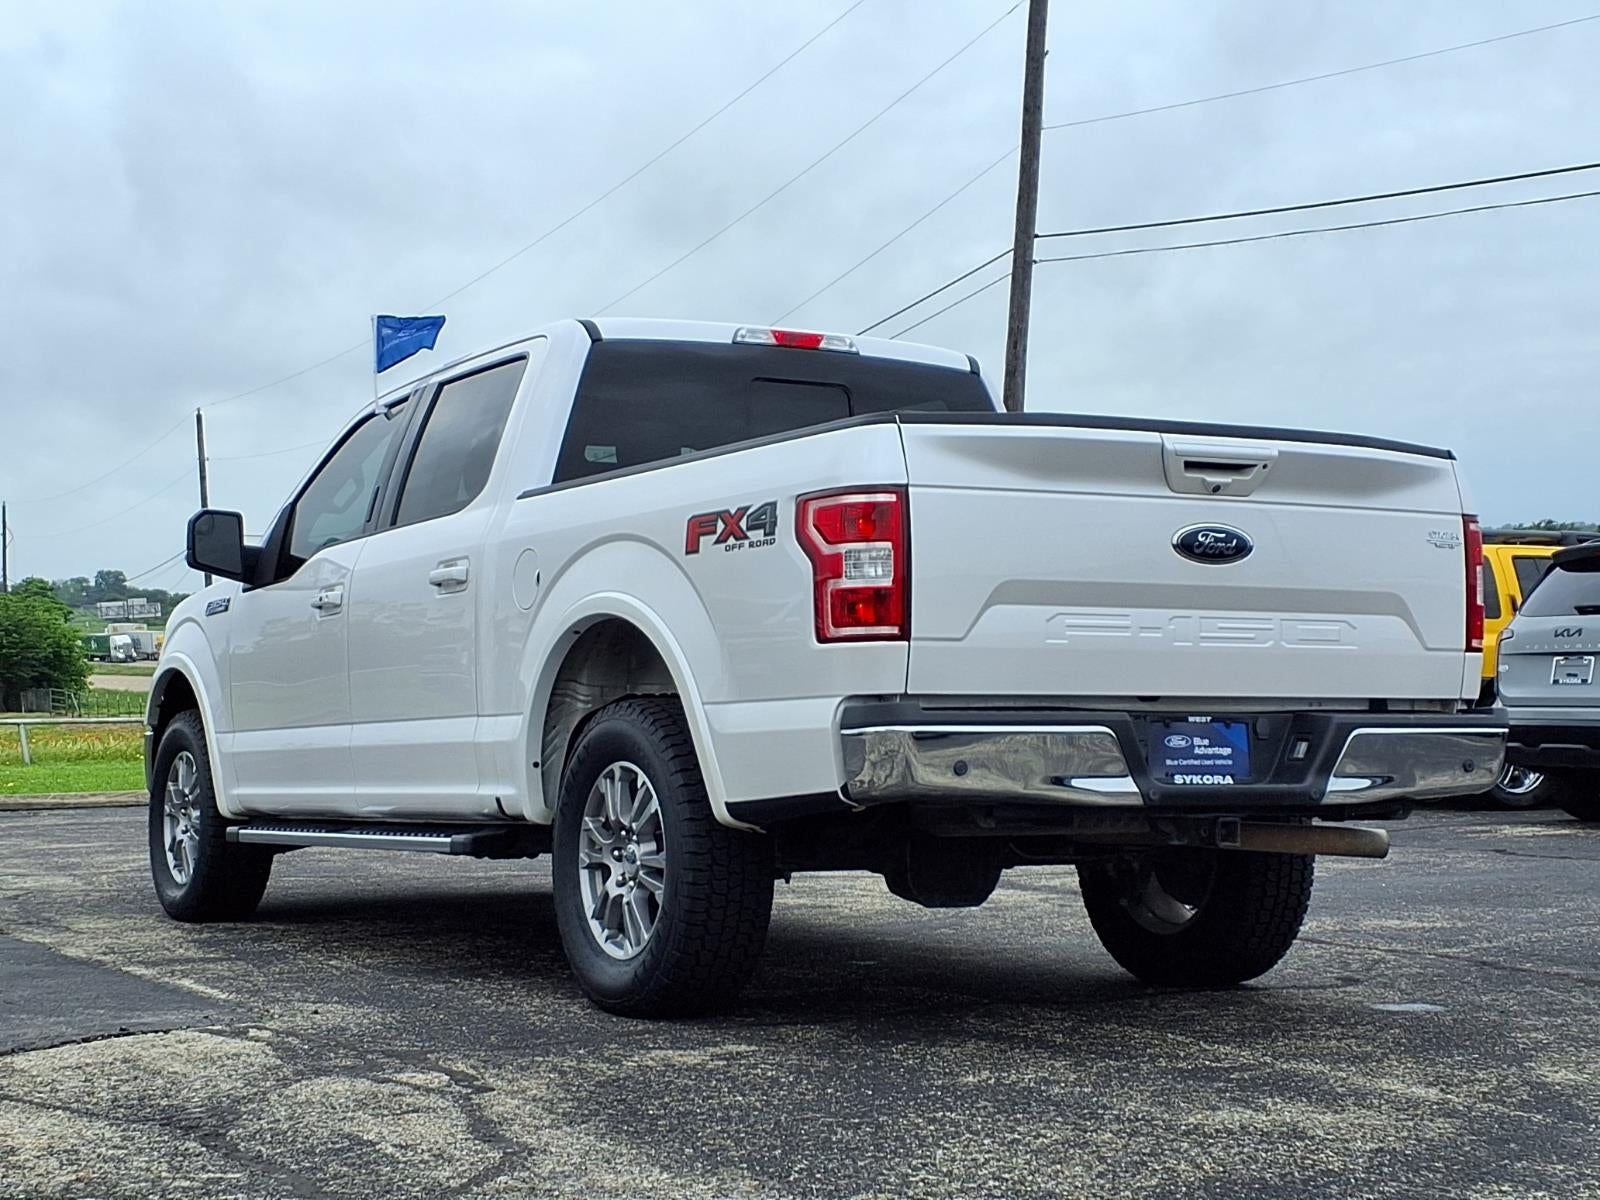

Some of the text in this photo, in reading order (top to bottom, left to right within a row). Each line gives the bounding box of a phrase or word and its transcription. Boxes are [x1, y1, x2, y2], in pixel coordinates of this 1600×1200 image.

[685, 500, 778, 555] FX4
[724, 537, 776, 552] OFF ROAD
[1193, 531, 1237, 554] Ford
[1193, 737, 1210, 746] Blue
[1194, 747, 1232, 756] Advantage
[1173, 774, 1234, 785] SYKORA
